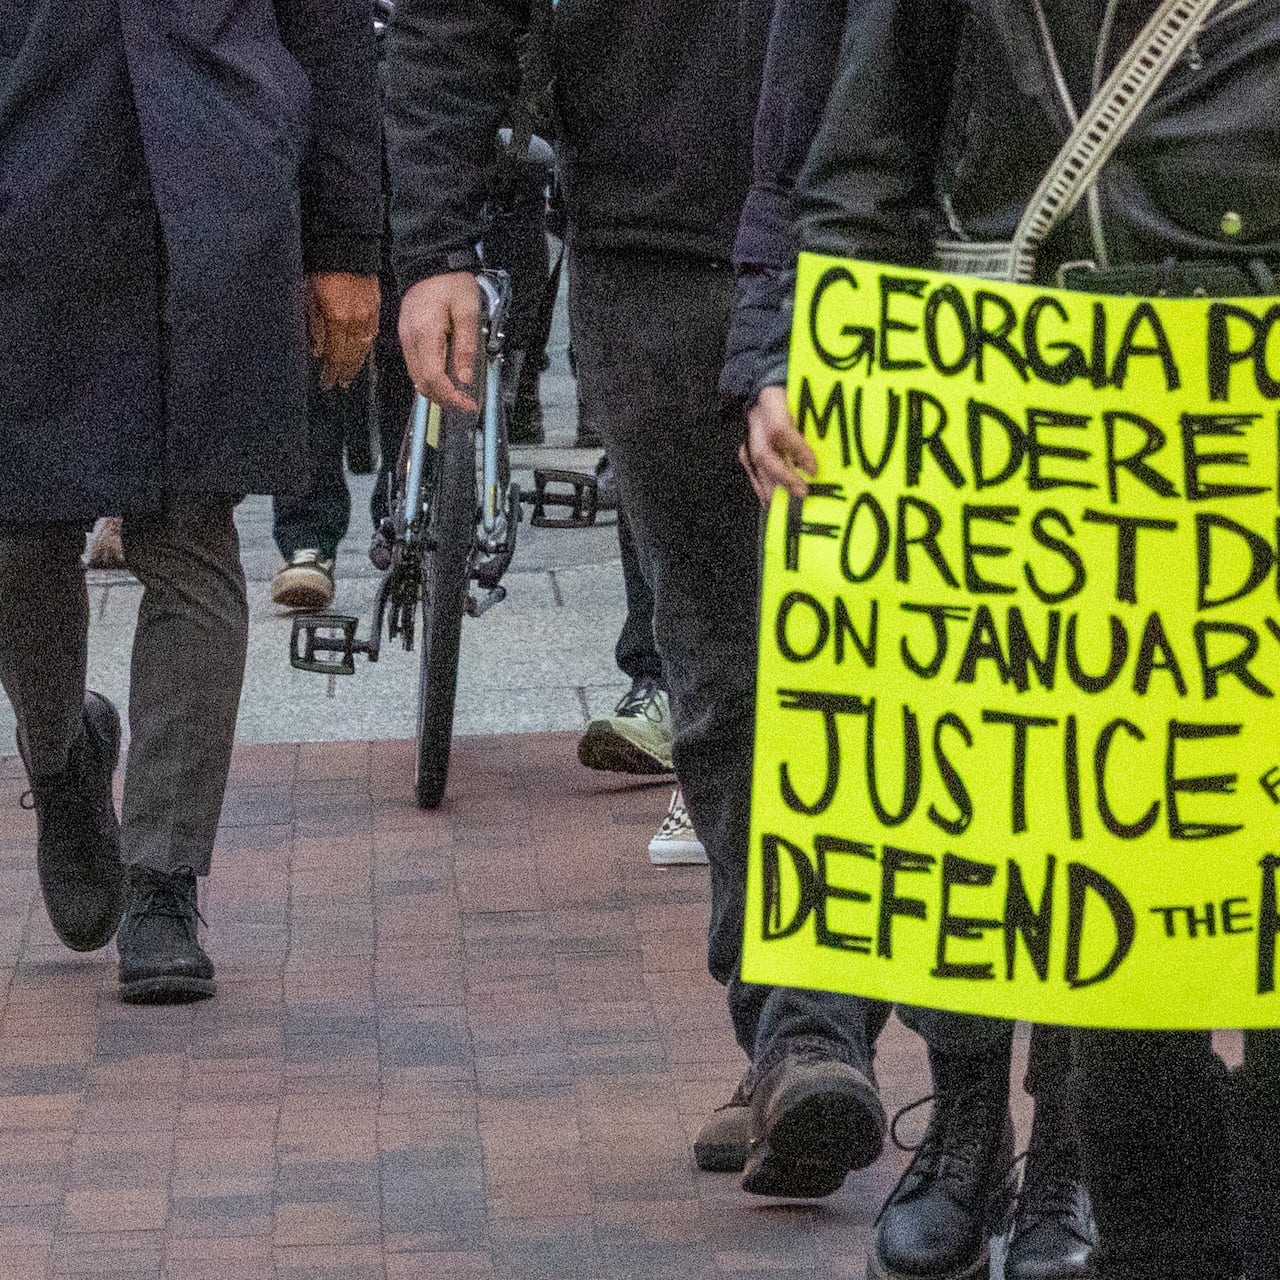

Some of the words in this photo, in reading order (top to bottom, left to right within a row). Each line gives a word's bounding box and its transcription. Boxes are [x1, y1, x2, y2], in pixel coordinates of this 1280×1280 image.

[808, 267, 1178, 390] GEORGIA
[782, 484, 1178, 604] FOREST
[776, 591, 878, 667] ON
[777, 689, 1243, 840] JUSTICE
[761, 833, 1136, 990] DEFEND
[1152, 900, 1255, 937] THE
